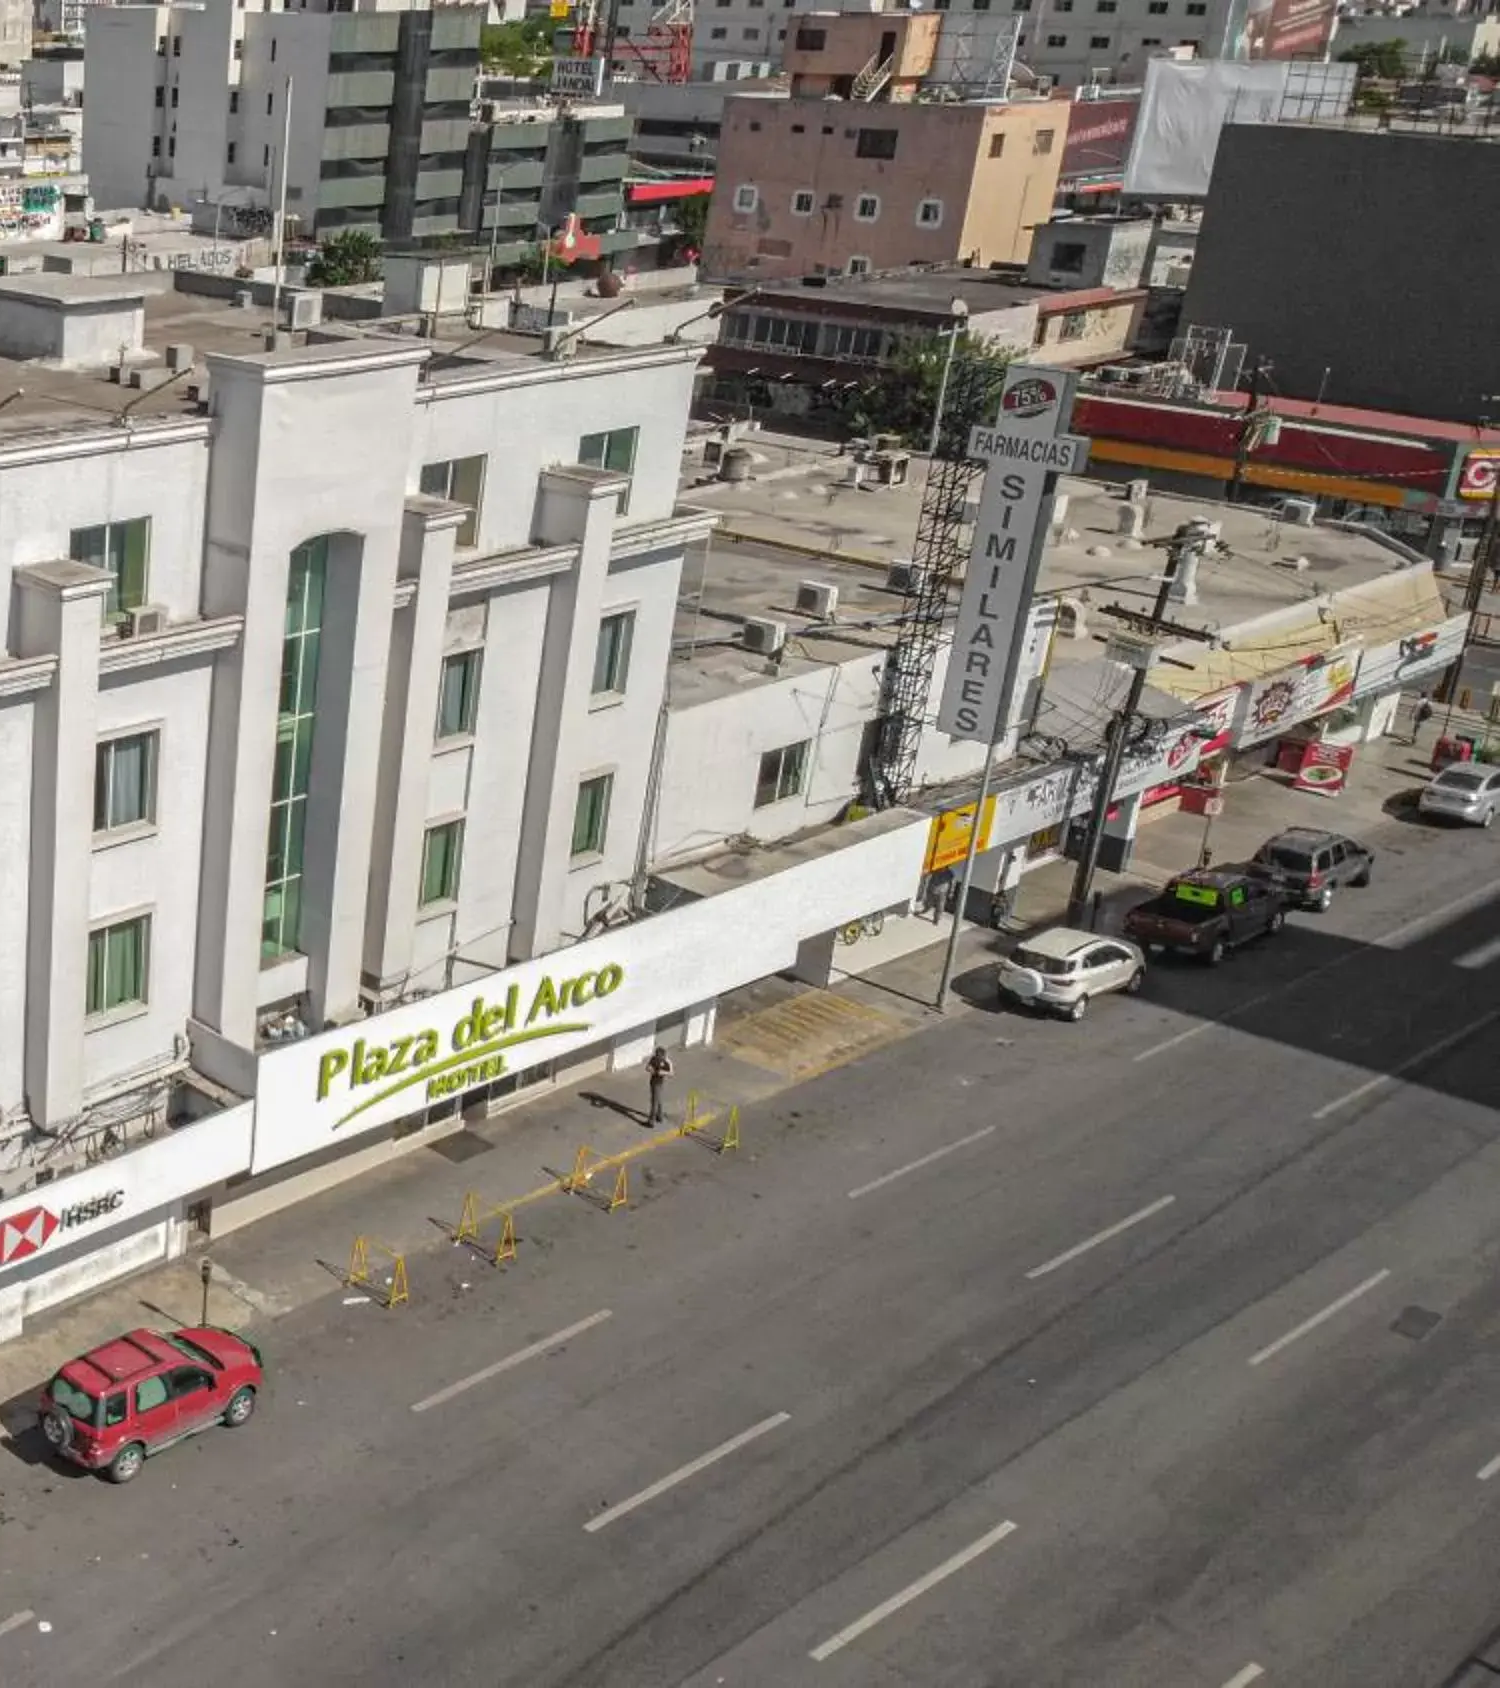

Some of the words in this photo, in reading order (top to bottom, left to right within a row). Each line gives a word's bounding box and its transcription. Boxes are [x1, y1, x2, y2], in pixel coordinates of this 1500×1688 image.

[974, 431, 1071, 466] FARMACIAS
[955, 474, 1026, 732] SIMILARES
[316, 1028, 440, 1102] Plaza
[452, 981, 520, 1050] del
[526, 962, 624, 1028] Arco
[427, 1055, 509, 1103] HOTEL
[60, 1189, 125, 1232] HSBC
